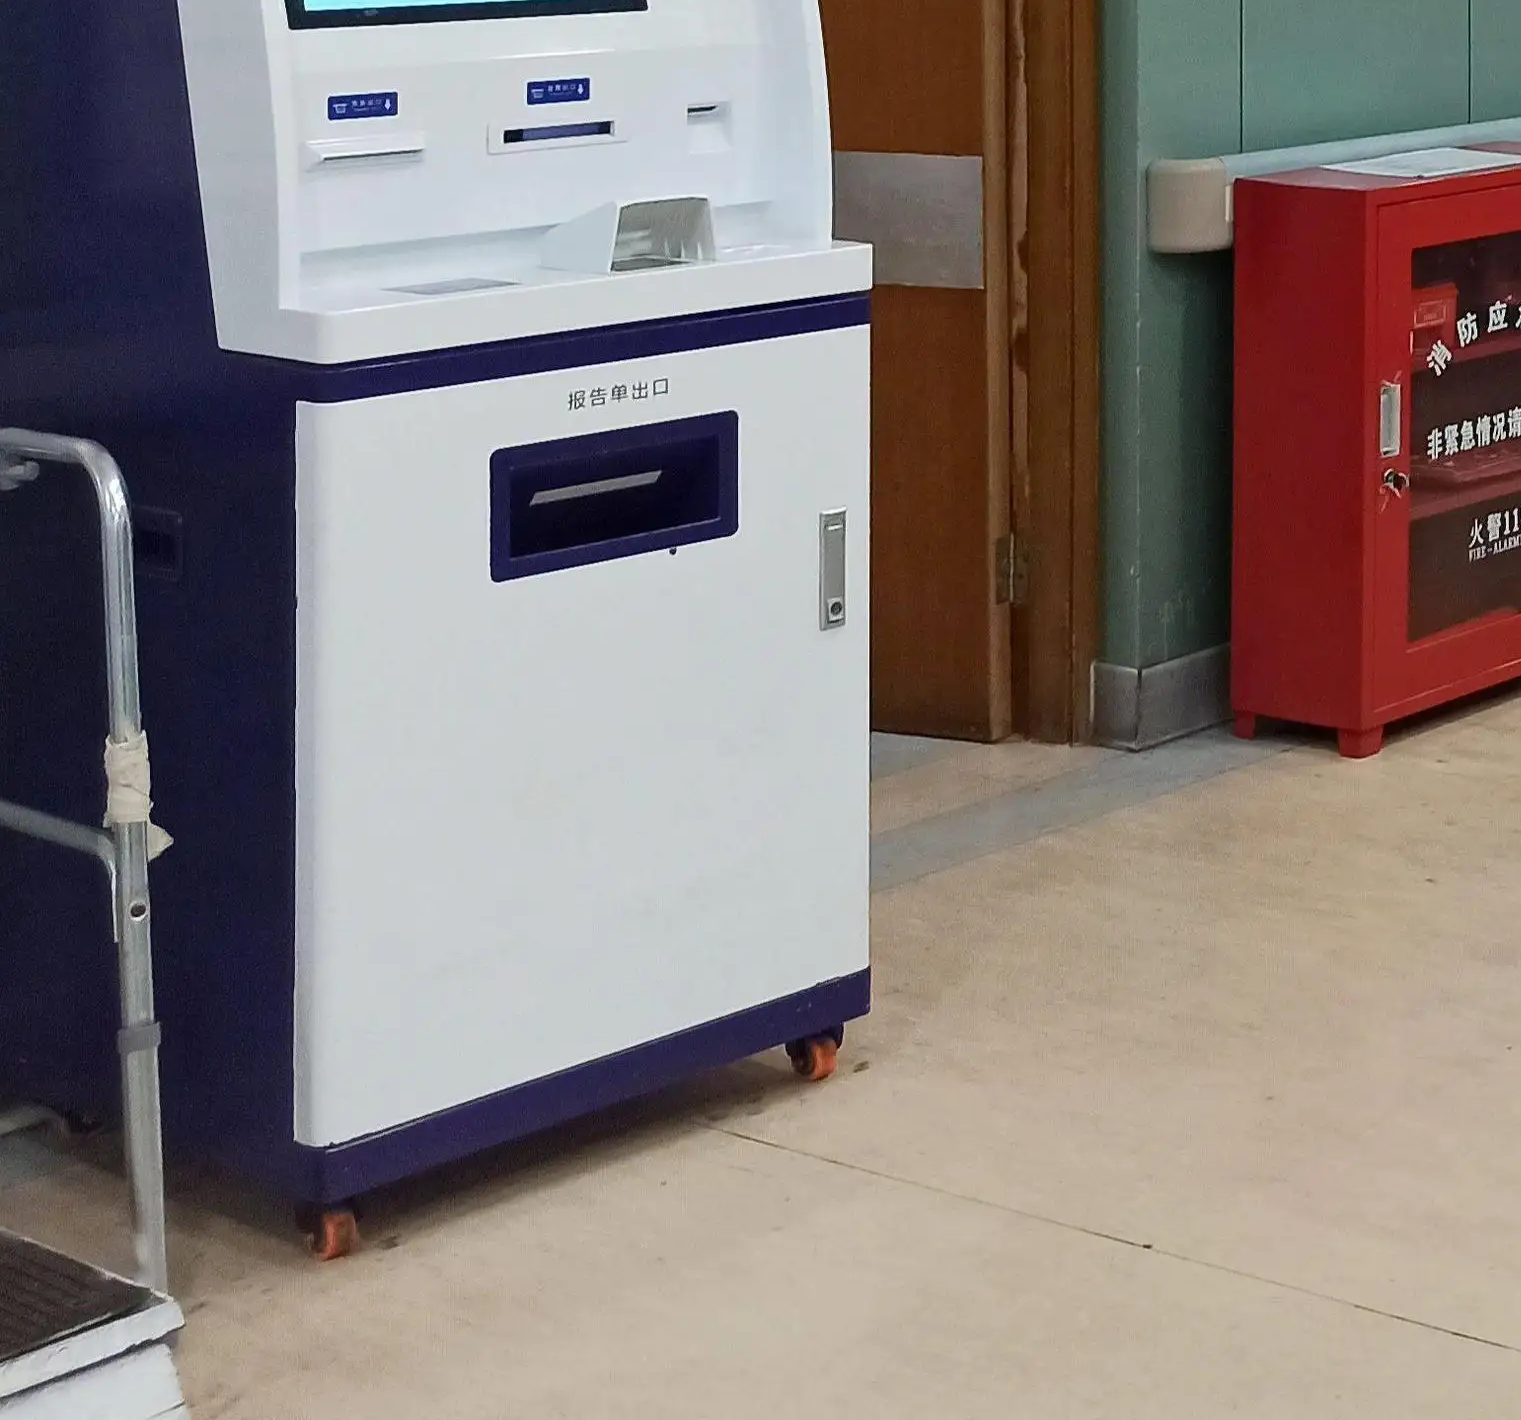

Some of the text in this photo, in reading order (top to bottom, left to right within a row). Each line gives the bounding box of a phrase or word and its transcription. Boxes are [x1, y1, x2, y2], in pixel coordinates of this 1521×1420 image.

[568, 377, 670, 411] 报告单出口
